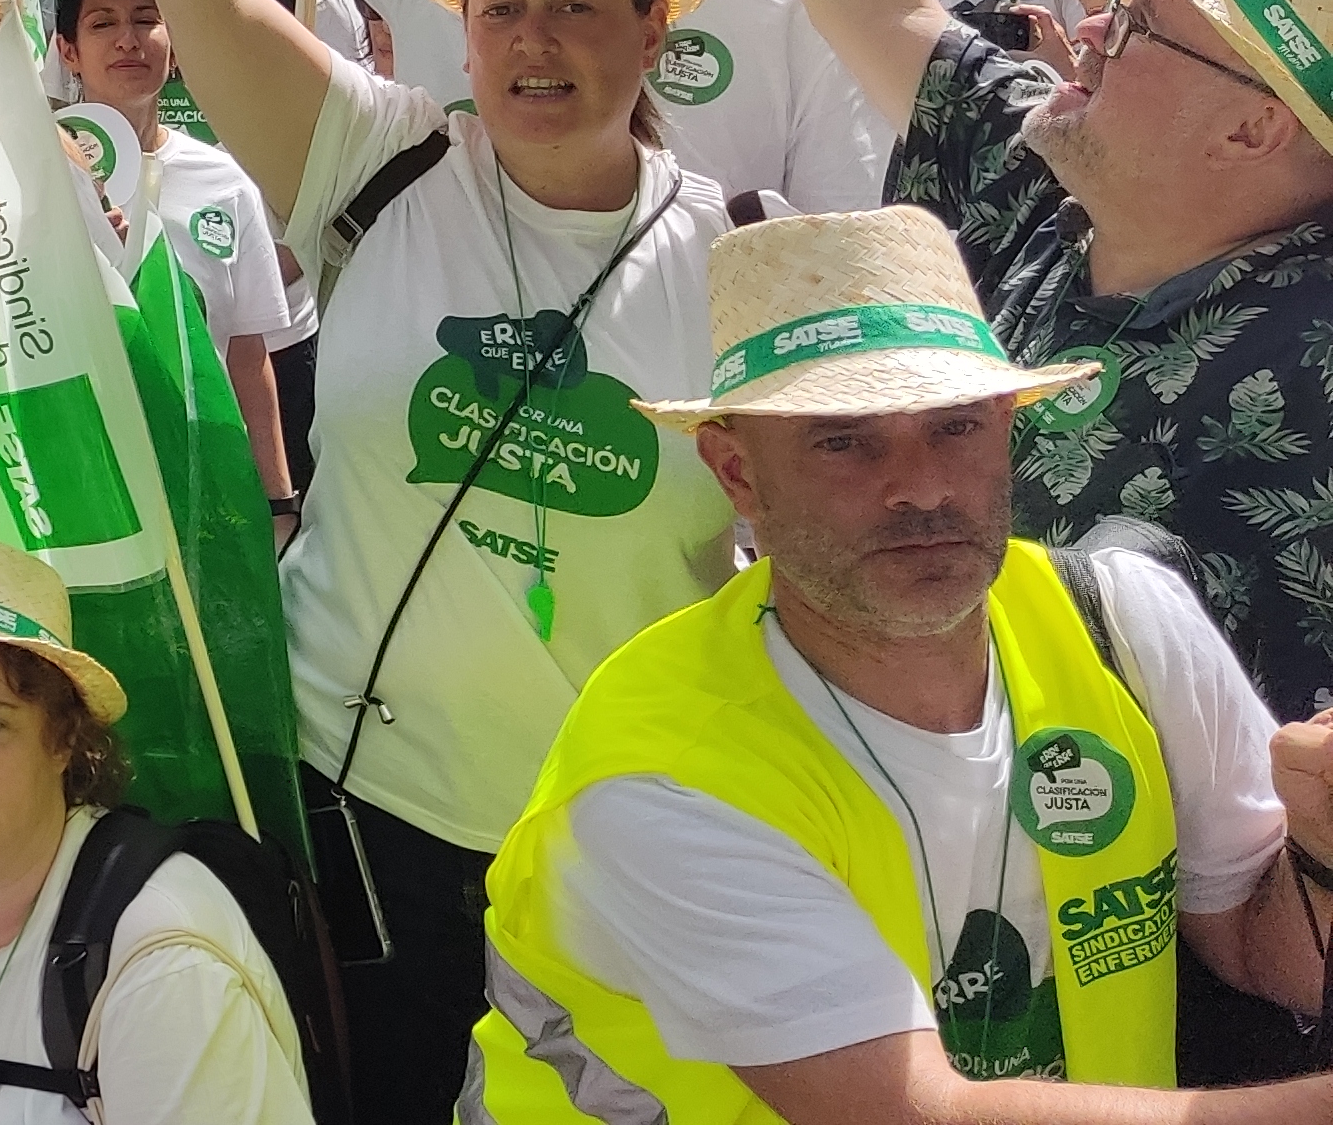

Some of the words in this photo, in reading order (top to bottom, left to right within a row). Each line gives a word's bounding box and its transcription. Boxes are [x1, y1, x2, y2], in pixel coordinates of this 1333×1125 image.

[1264, 4, 1323, 70] SATSE
[773, 314, 862, 355] SATSE
[481, 346, 509, 359] QUE
[457, 519, 560, 573] SATSE
[1036, 785, 1108, 797] CLASIFICACIÓN
[1044, 797, 1090, 811] JUSTA
[1051, 832, 1094, 845] SATSE
[994, 1047, 1030, 1075] UNA
